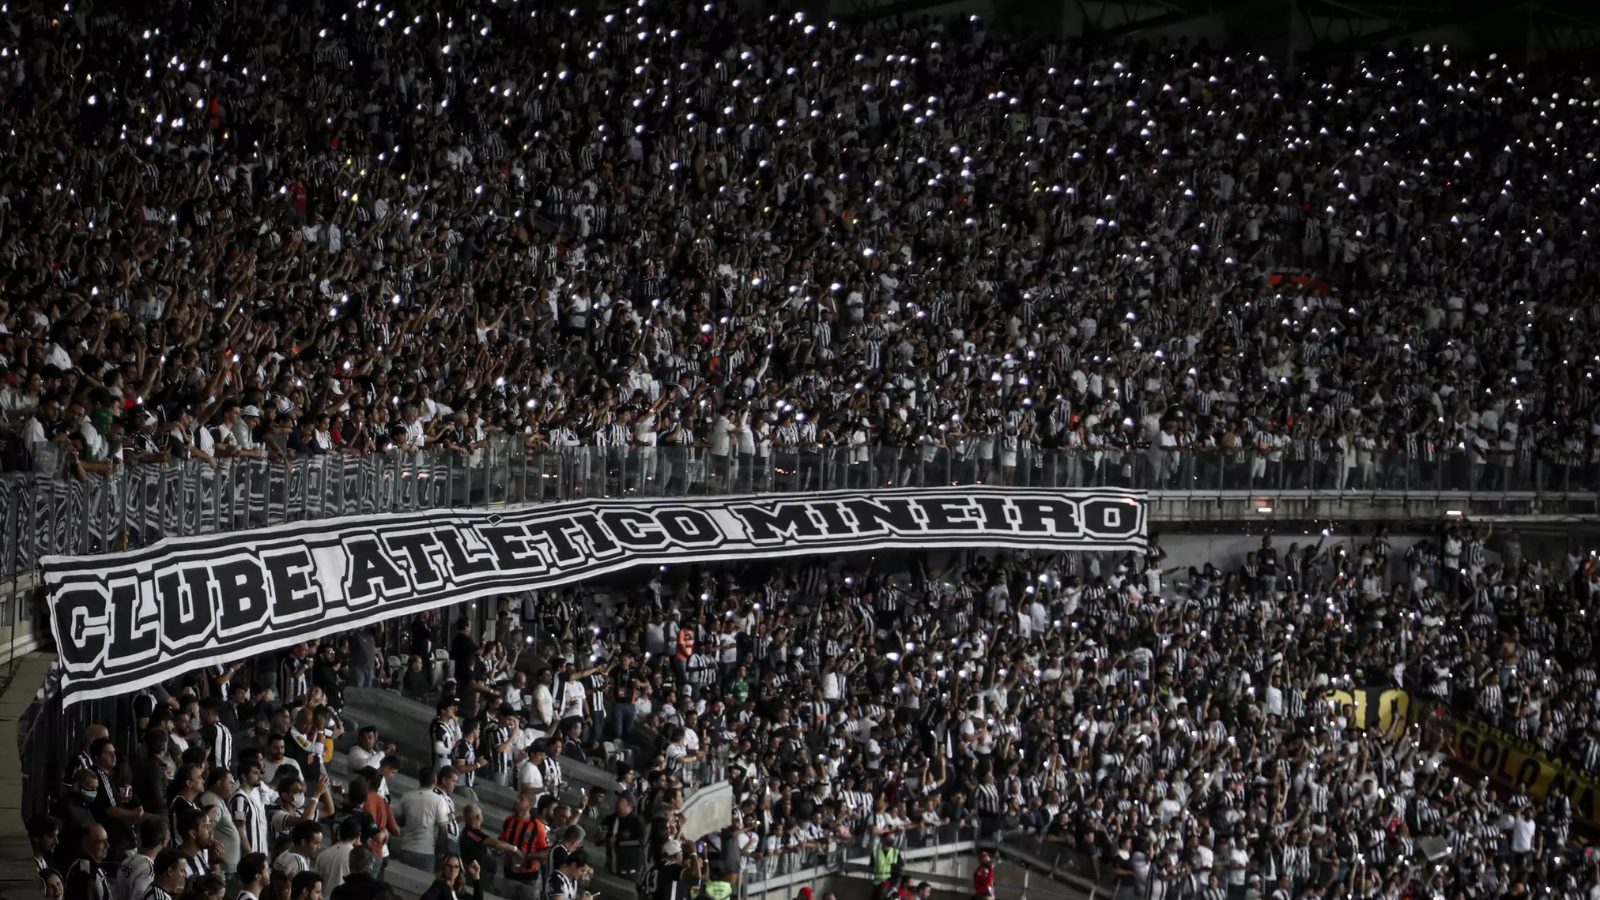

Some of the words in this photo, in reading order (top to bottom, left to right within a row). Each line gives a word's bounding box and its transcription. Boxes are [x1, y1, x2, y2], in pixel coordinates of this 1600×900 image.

[53, 549, 322, 667] CLUBE
[345, 508, 719, 601] ATLÉTICO
[738, 497, 1139, 541] MINEIRO
